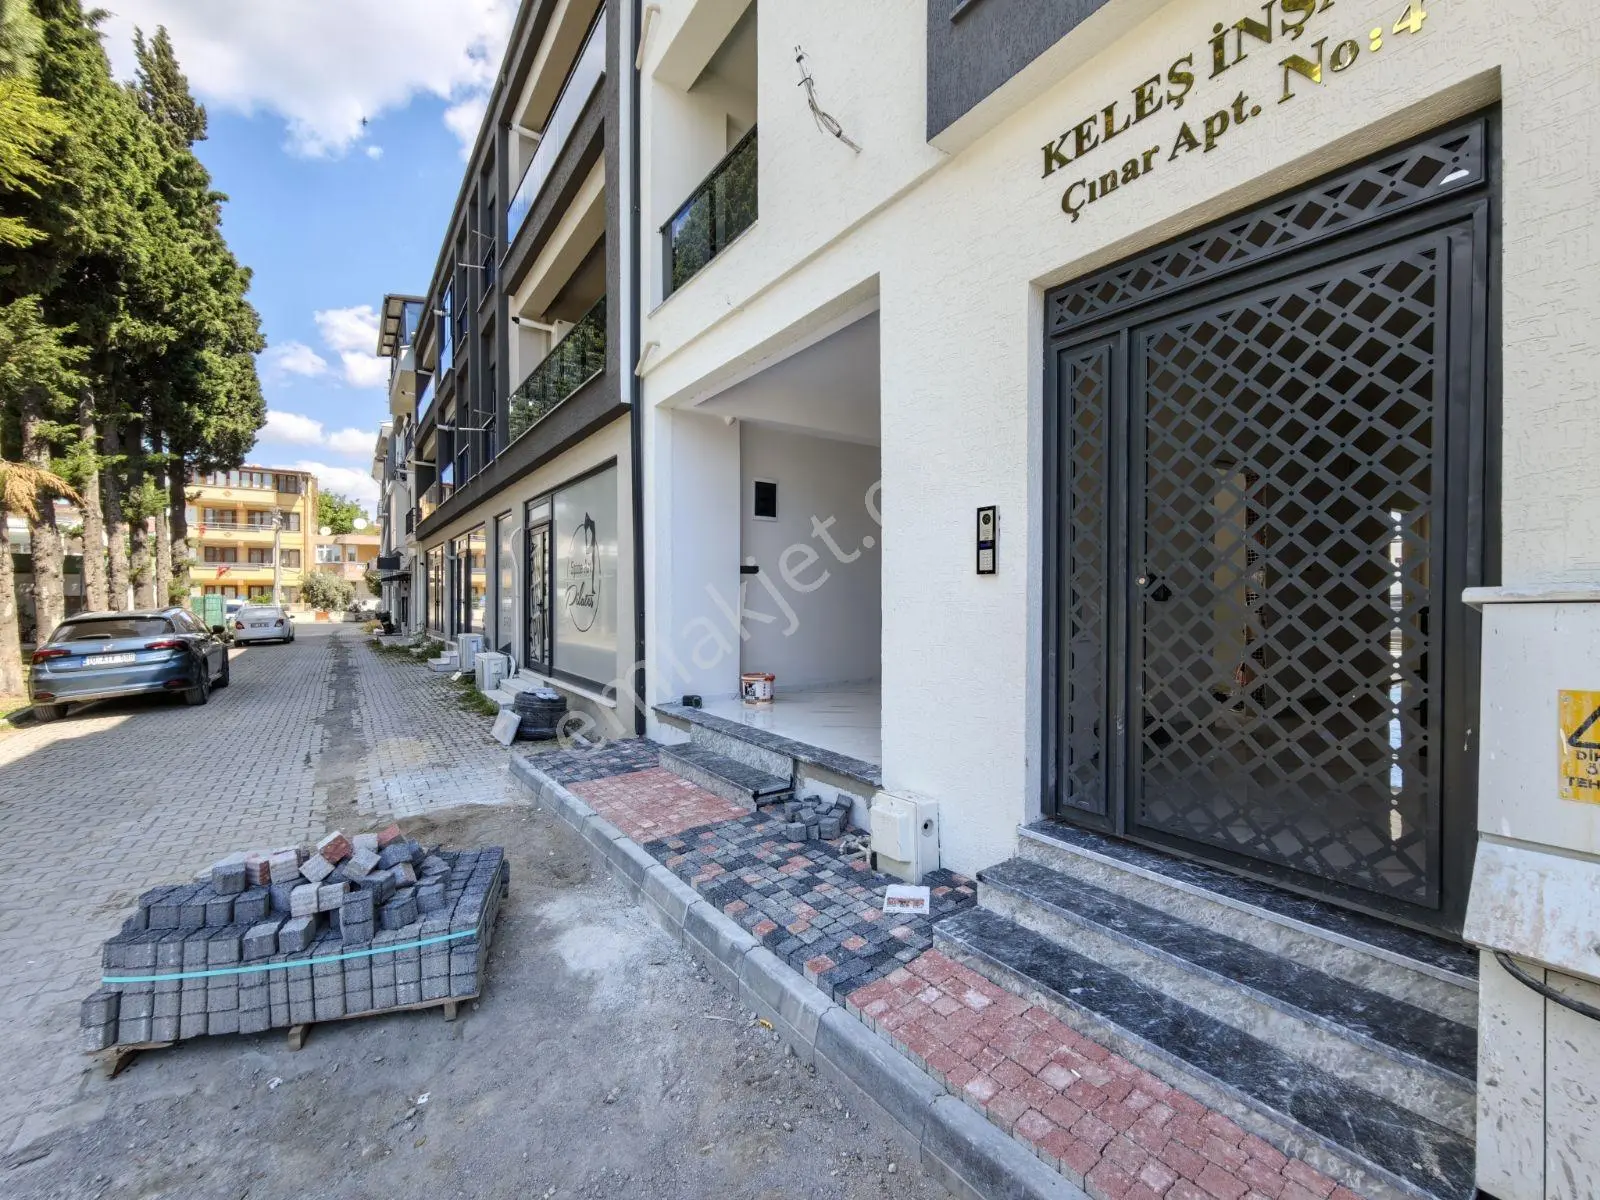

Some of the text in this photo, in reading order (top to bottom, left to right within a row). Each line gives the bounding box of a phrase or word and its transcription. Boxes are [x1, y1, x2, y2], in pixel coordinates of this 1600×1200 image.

[1041, 0, 1335, 179] KELEŞ İNŞ
[1061, 144, 1160, 223] Çınar
[1168, 90, 1261, 161] Apt.
